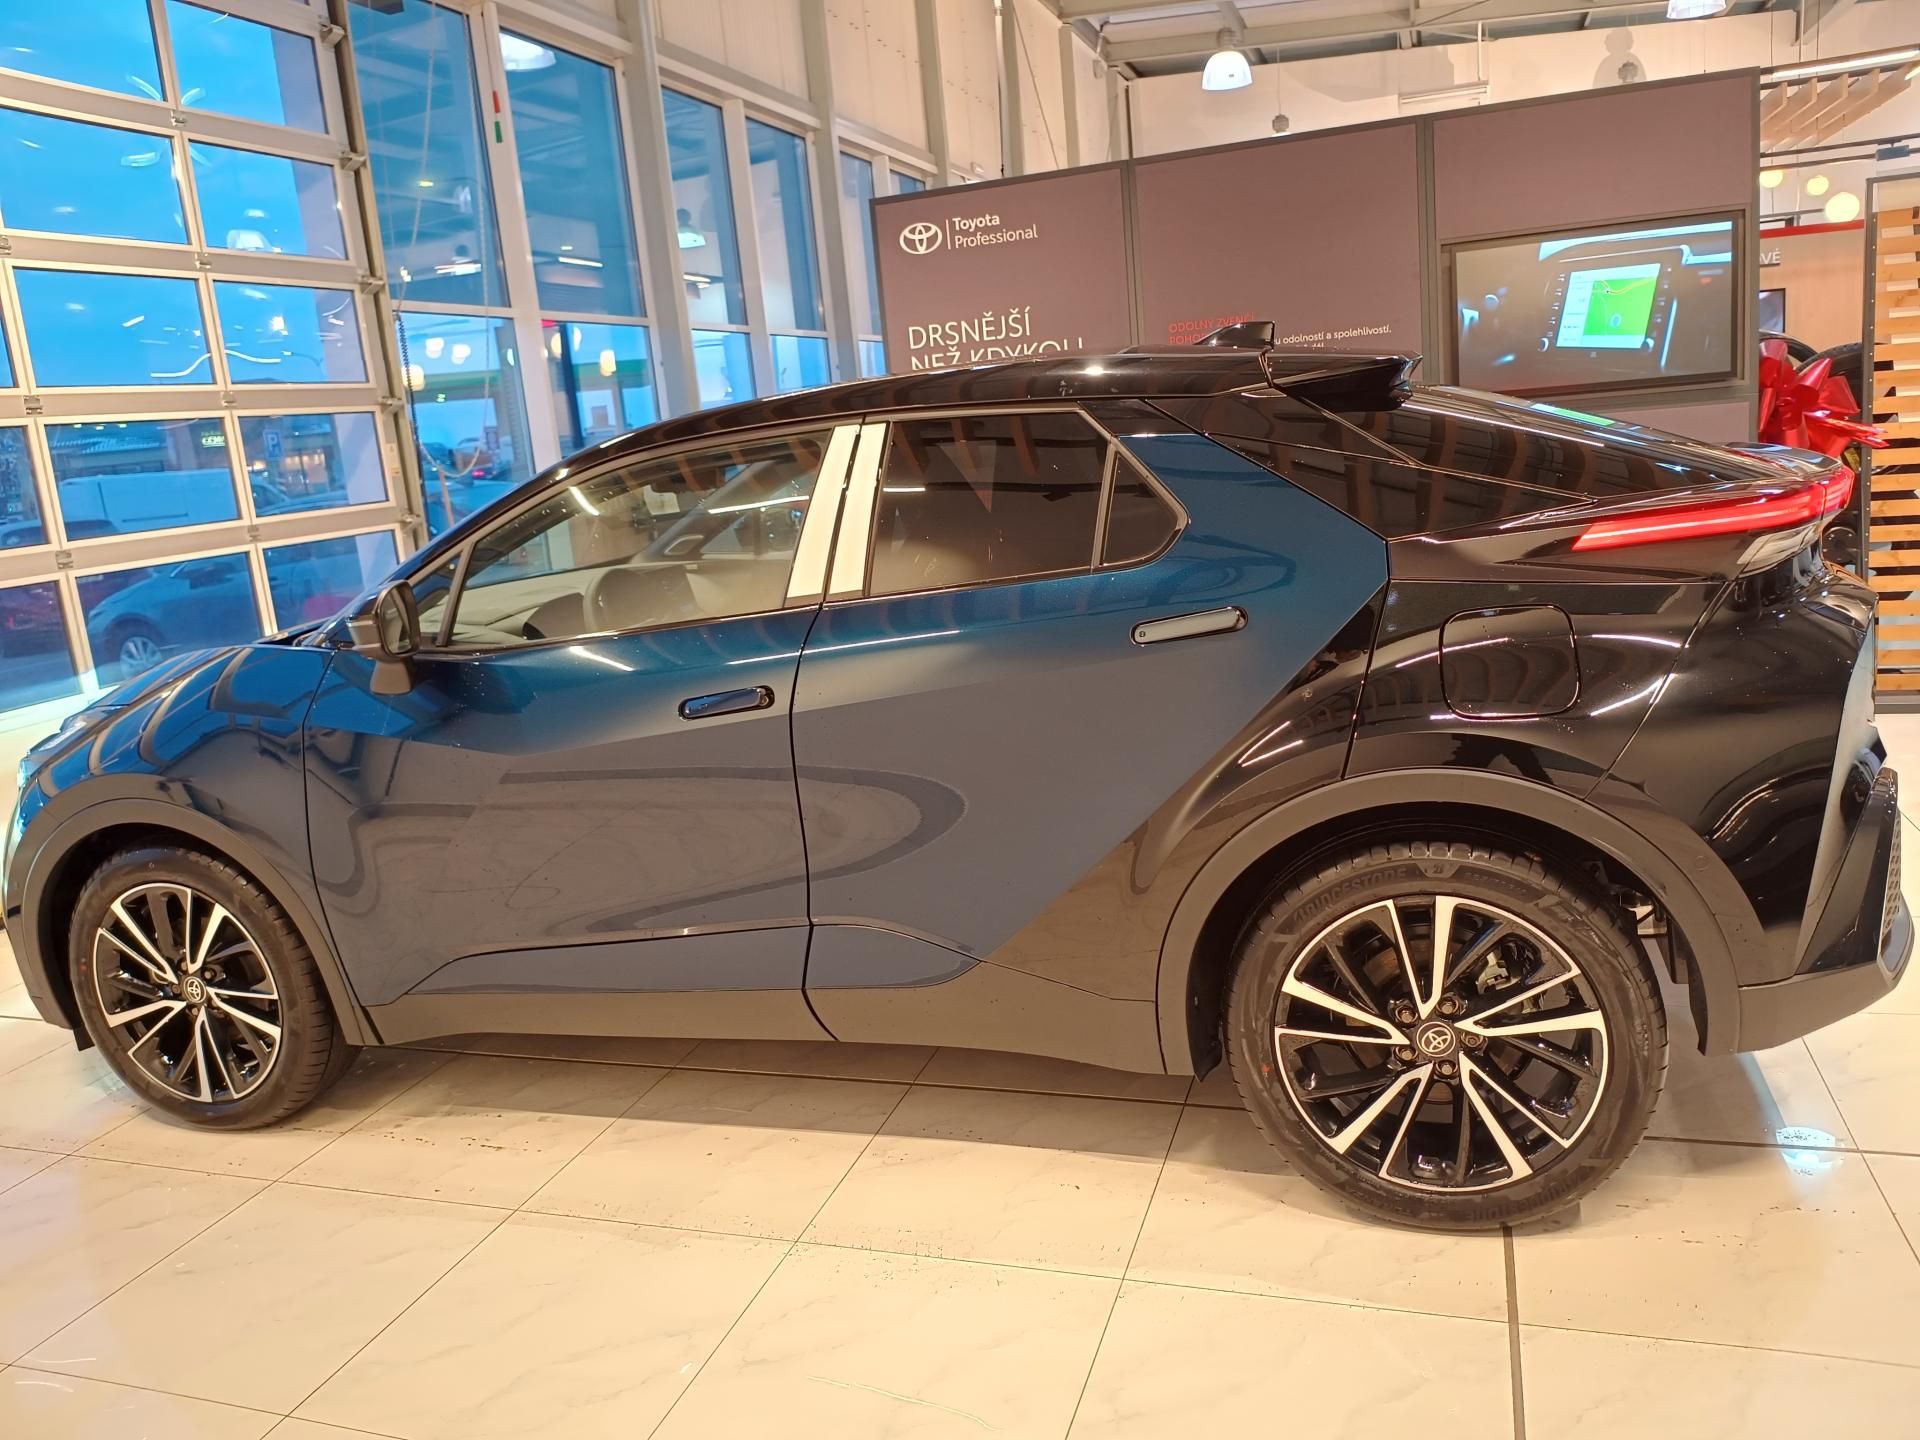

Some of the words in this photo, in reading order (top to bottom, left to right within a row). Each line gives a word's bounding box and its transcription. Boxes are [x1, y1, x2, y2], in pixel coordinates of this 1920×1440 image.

[952, 213, 1000, 231] Toyota
[954, 223, 1038, 249] Professional
[1760, 248, 1781, 264] VÉ
[908, 306, 1031, 350] DRSNĚJŠÍ
[1282, 331, 1324, 344] odolností
[1326, 332, 1332, 340] a
[1333, 324, 1392, 341] spolehlivostí.
